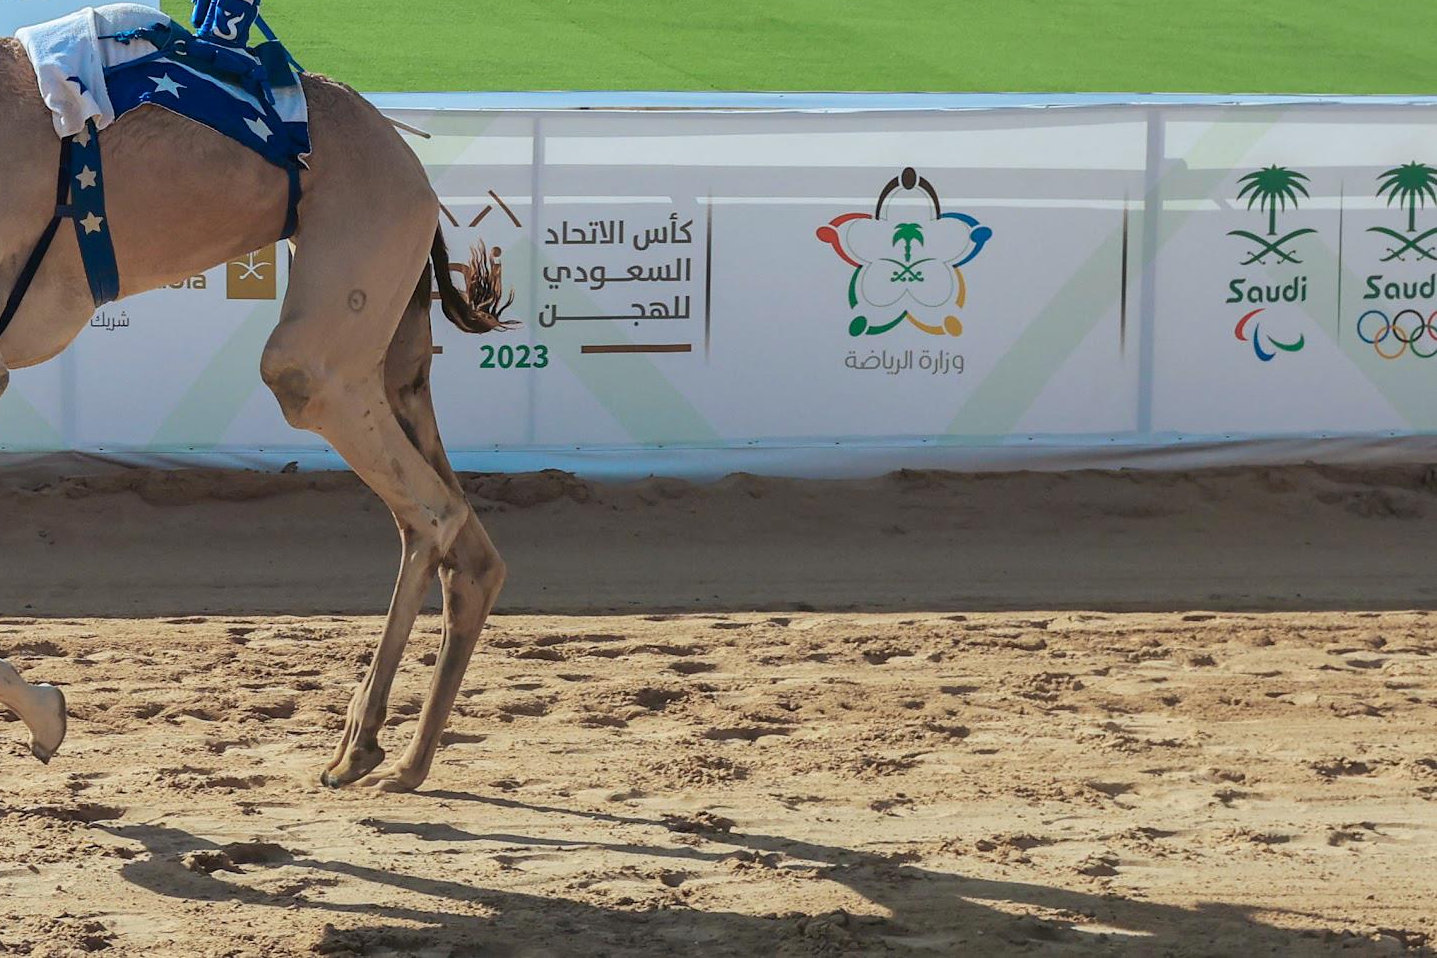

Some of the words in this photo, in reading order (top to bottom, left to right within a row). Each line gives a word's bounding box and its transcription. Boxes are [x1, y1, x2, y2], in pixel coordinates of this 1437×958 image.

[545, 220, 624, 245] الاتحاد
[633, 212, 693, 251] كأس
[543, 257, 691, 291] السعودي
[1363, 273, 1437, 300] Saud
[1226, 276, 1307, 304] Saudi
[90, 310, 130, 331] شريك
[539, 295, 691, 328] للهجن
[479, 344, 549, 369] 2023
[844, 349, 913, 375] الرياضة
[918, 349, 964, 375] وزارة
